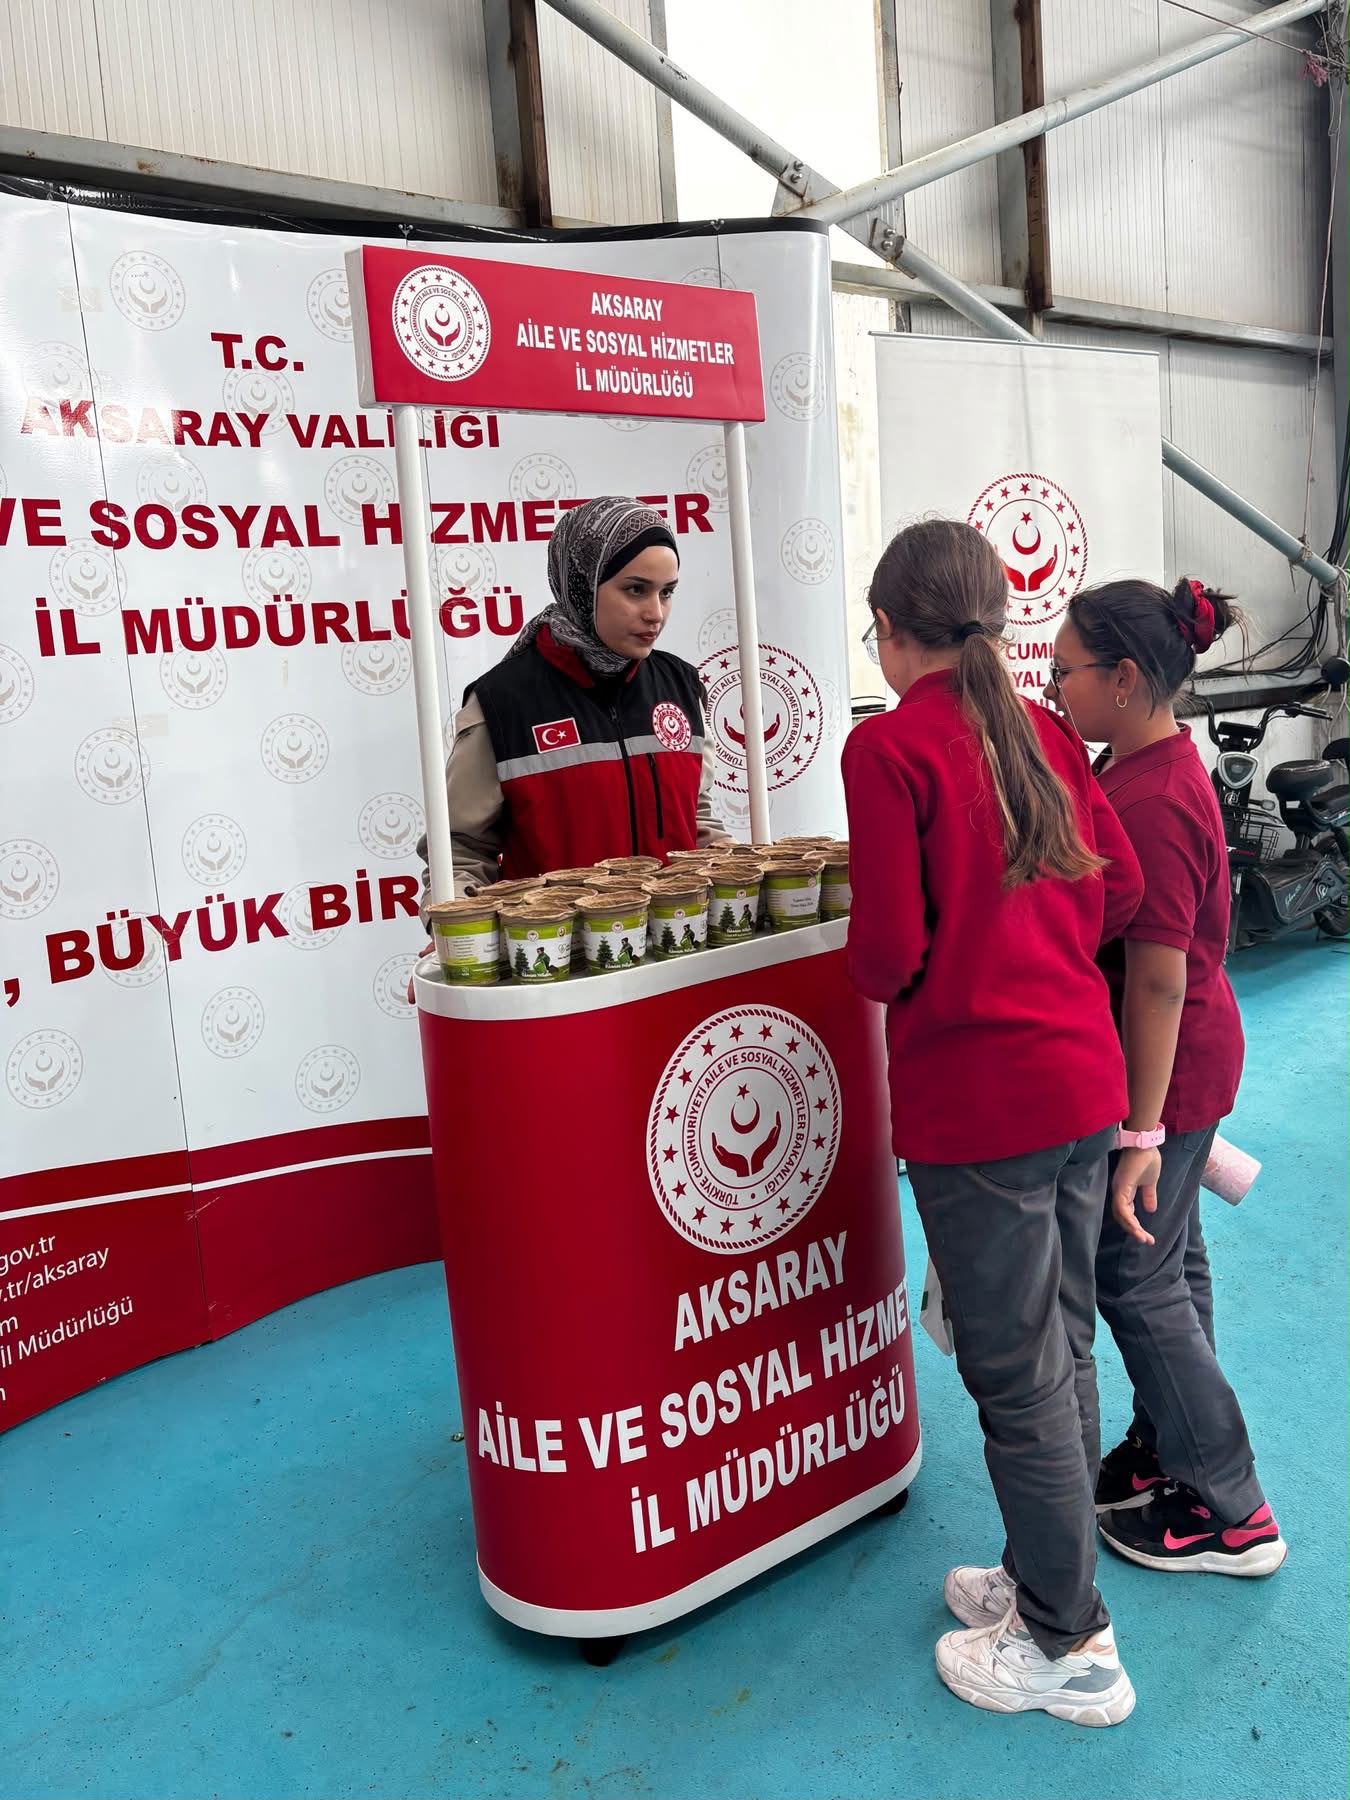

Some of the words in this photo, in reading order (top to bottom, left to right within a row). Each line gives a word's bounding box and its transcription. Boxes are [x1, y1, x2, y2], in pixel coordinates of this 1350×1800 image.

[592, 292, 663, 322] AKSARAY
[210, 333, 304, 372] T.C.
[516, 317, 556, 350] AİLE
[558, 326, 583, 352] VE
[586, 330, 648, 358] SOSYAL
[650, 332, 735, 366] HİZMETLER
[575, 362, 593, 392] İL
[596, 364, 694, 399] MÜDÜRLÜĞÜ
[21, 396, 270, 448] AKSARAY
[89, 499, 341, 550] SOSYAL
[35, 597, 101, 657] İL
[720, 674, 738, 690] AİLE
[45, 892, 290, 984] BÜYÜK
[308, 868, 420, 931] BİR
[704, 1066, 725, 1089] AİLE
[724, 1055, 740, 1069] VE
[740, 1051, 779, 1071] SOSYAL
[779, 1066, 806, 1129] HİZMETLER
[686, 1083, 707, 1177] CUMHURİYETİ
[764, 1133, 805, 1195] BAKANLIĞI
[699, 1175, 739, 1207] TÜRKİYE
[673, 1229, 849, 1352] AKSARAY
[18, 1295, 134, 1361] Müdürlüğü
[477, 1400, 568, 1474] AİLE
[577, 1405, 648, 1470] VE
[659, 1340, 813, 1450] SOSYAL
[630, 1486, 676, 1554] İL
[685, 1362, 906, 1534] MÜDÜRLÜĞÜ
